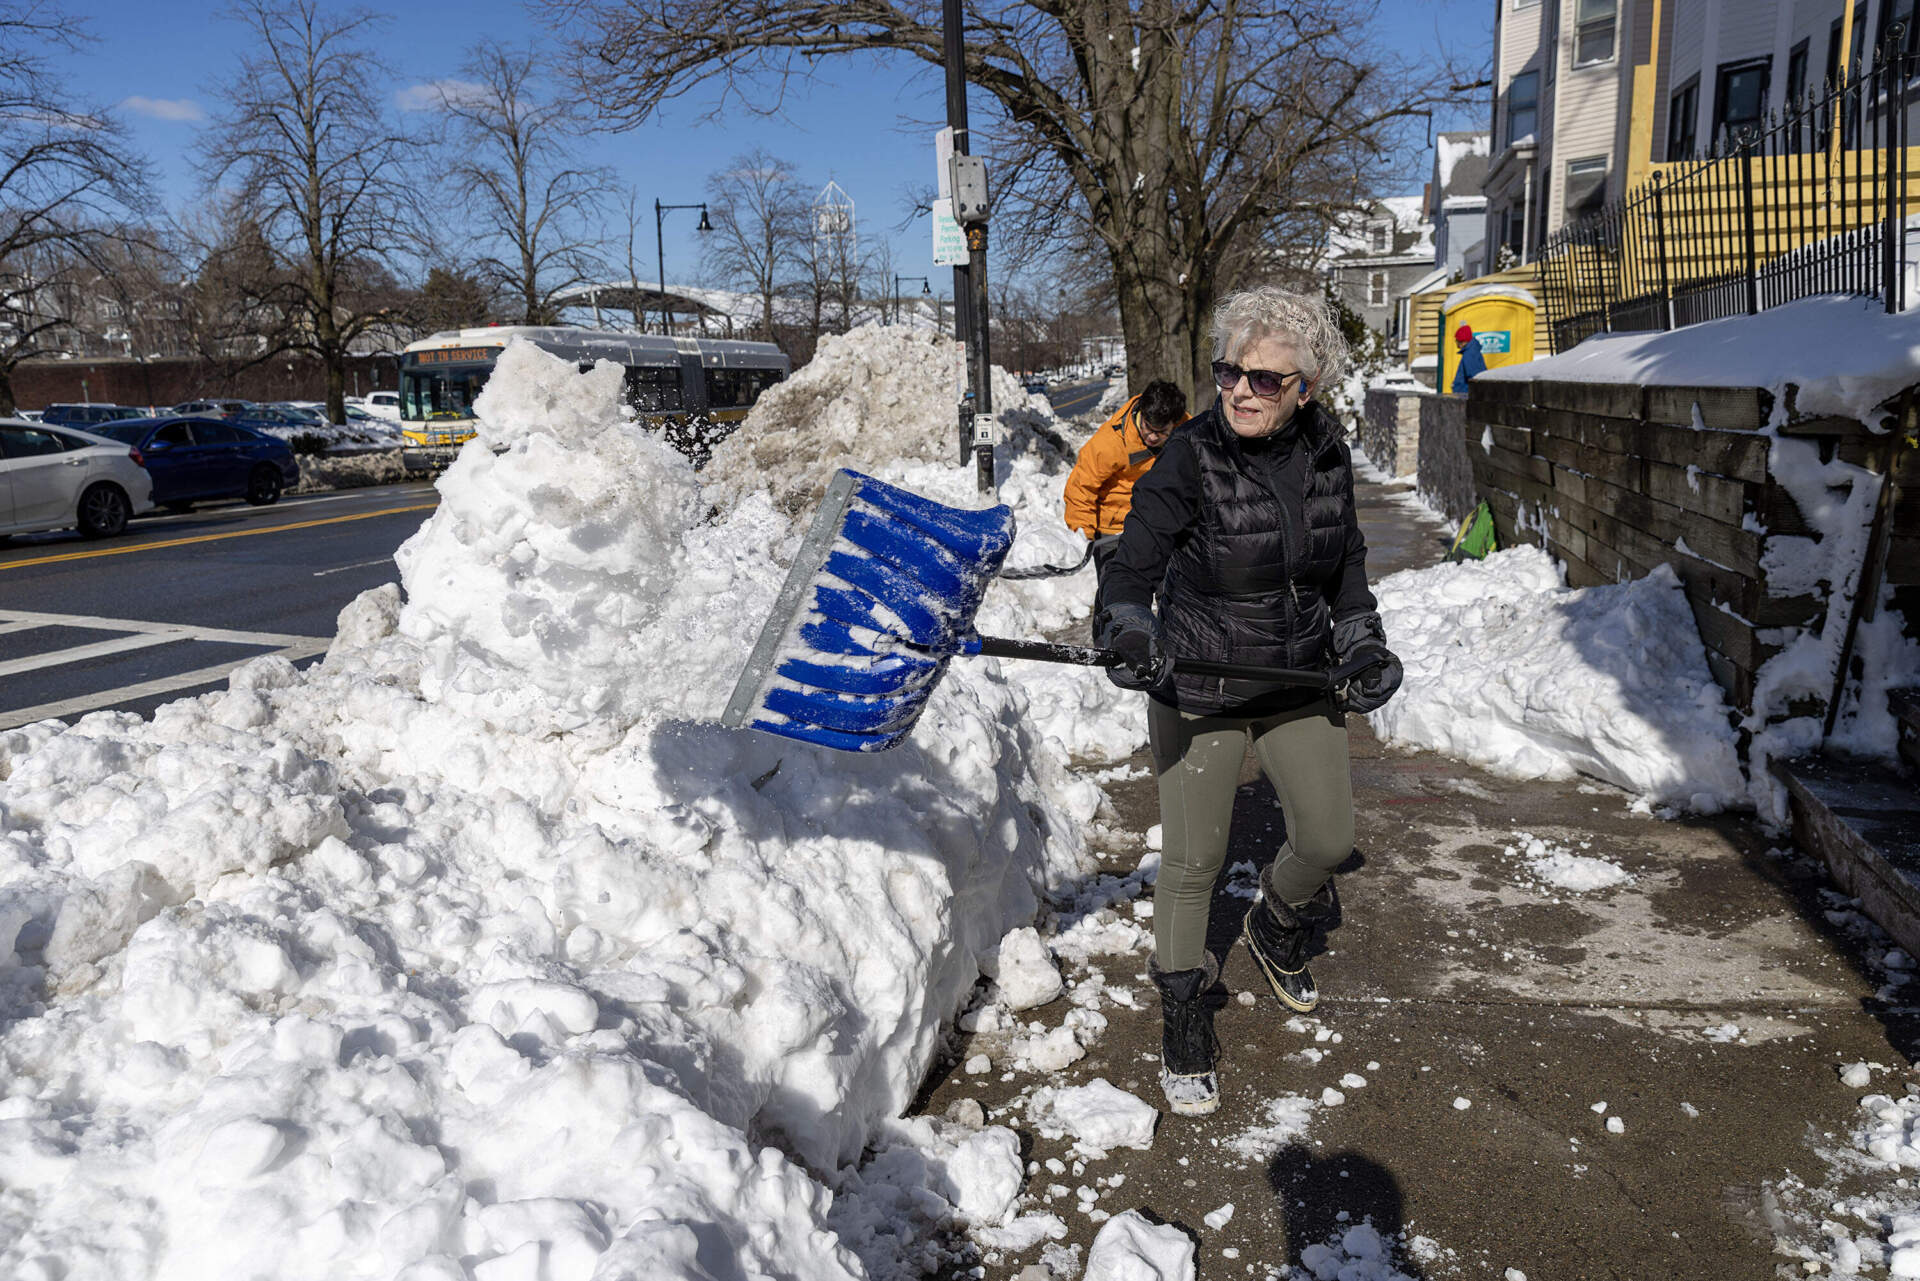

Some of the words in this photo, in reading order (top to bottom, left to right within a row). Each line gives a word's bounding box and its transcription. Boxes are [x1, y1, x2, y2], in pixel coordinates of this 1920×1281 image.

[940, 235, 961, 244] Parking
[418, 352, 435, 363] NOT
[438, 351, 448, 362] IN
[451, 348, 488, 361] SERVICE
